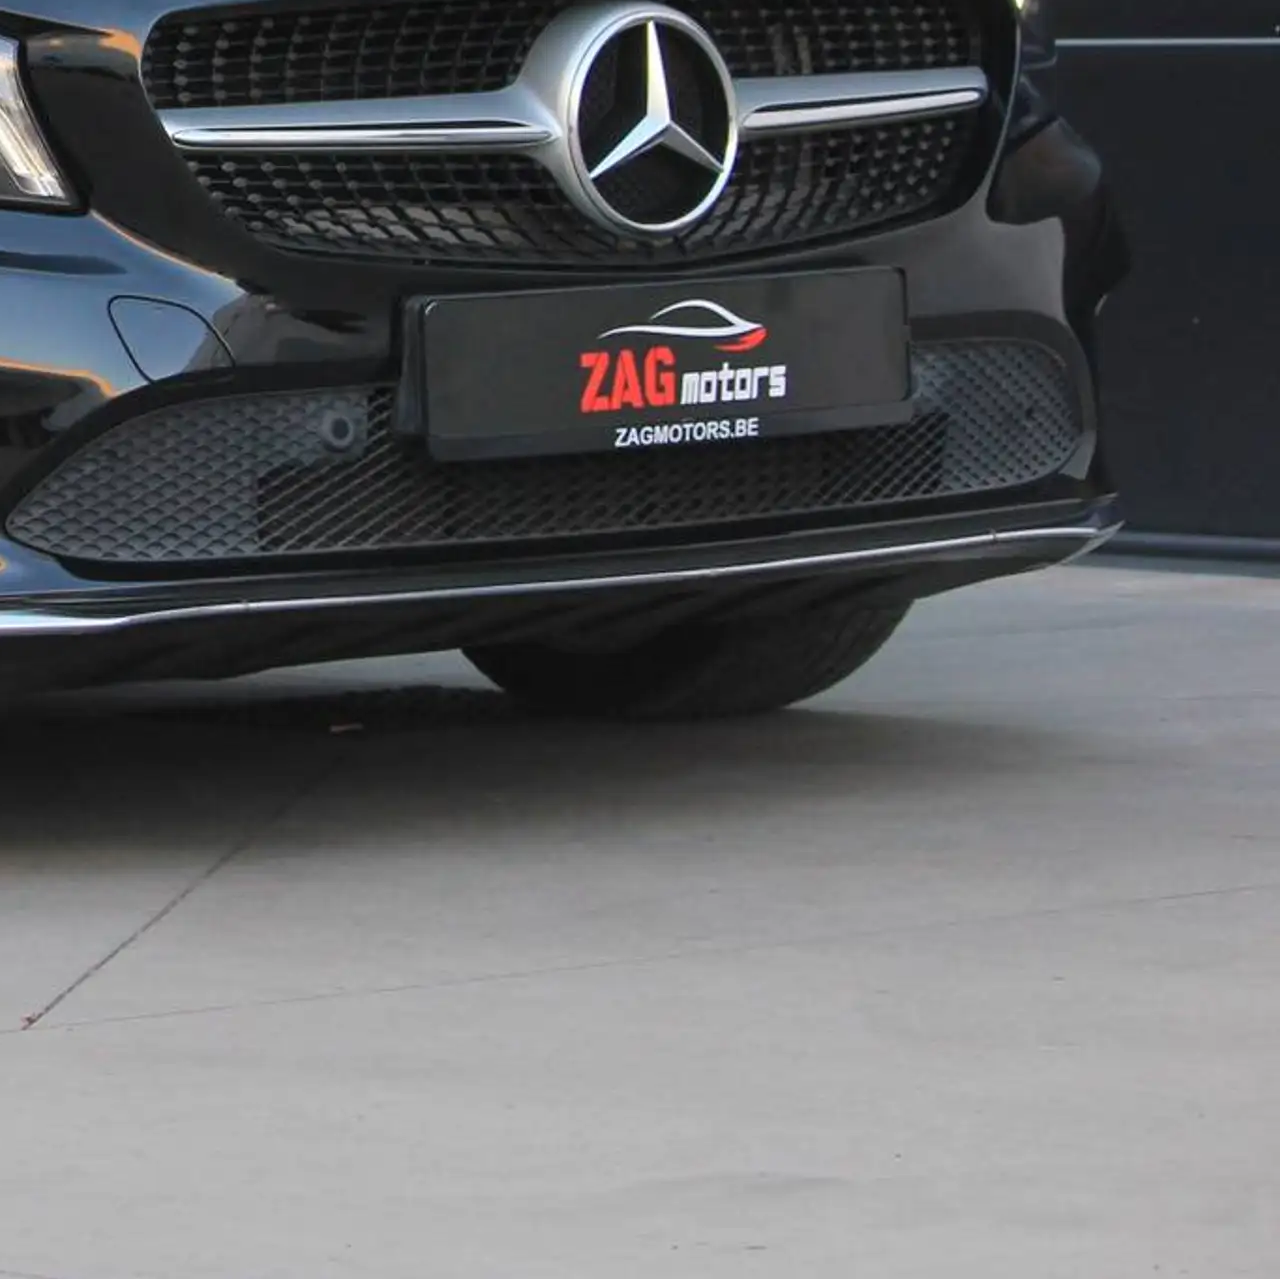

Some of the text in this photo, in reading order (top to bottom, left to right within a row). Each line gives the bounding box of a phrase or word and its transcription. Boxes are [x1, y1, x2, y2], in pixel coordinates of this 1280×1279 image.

[580, 346, 787, 413] ZAG motors
[614, 418, 759, 447] ZAGMOTORS.BE
